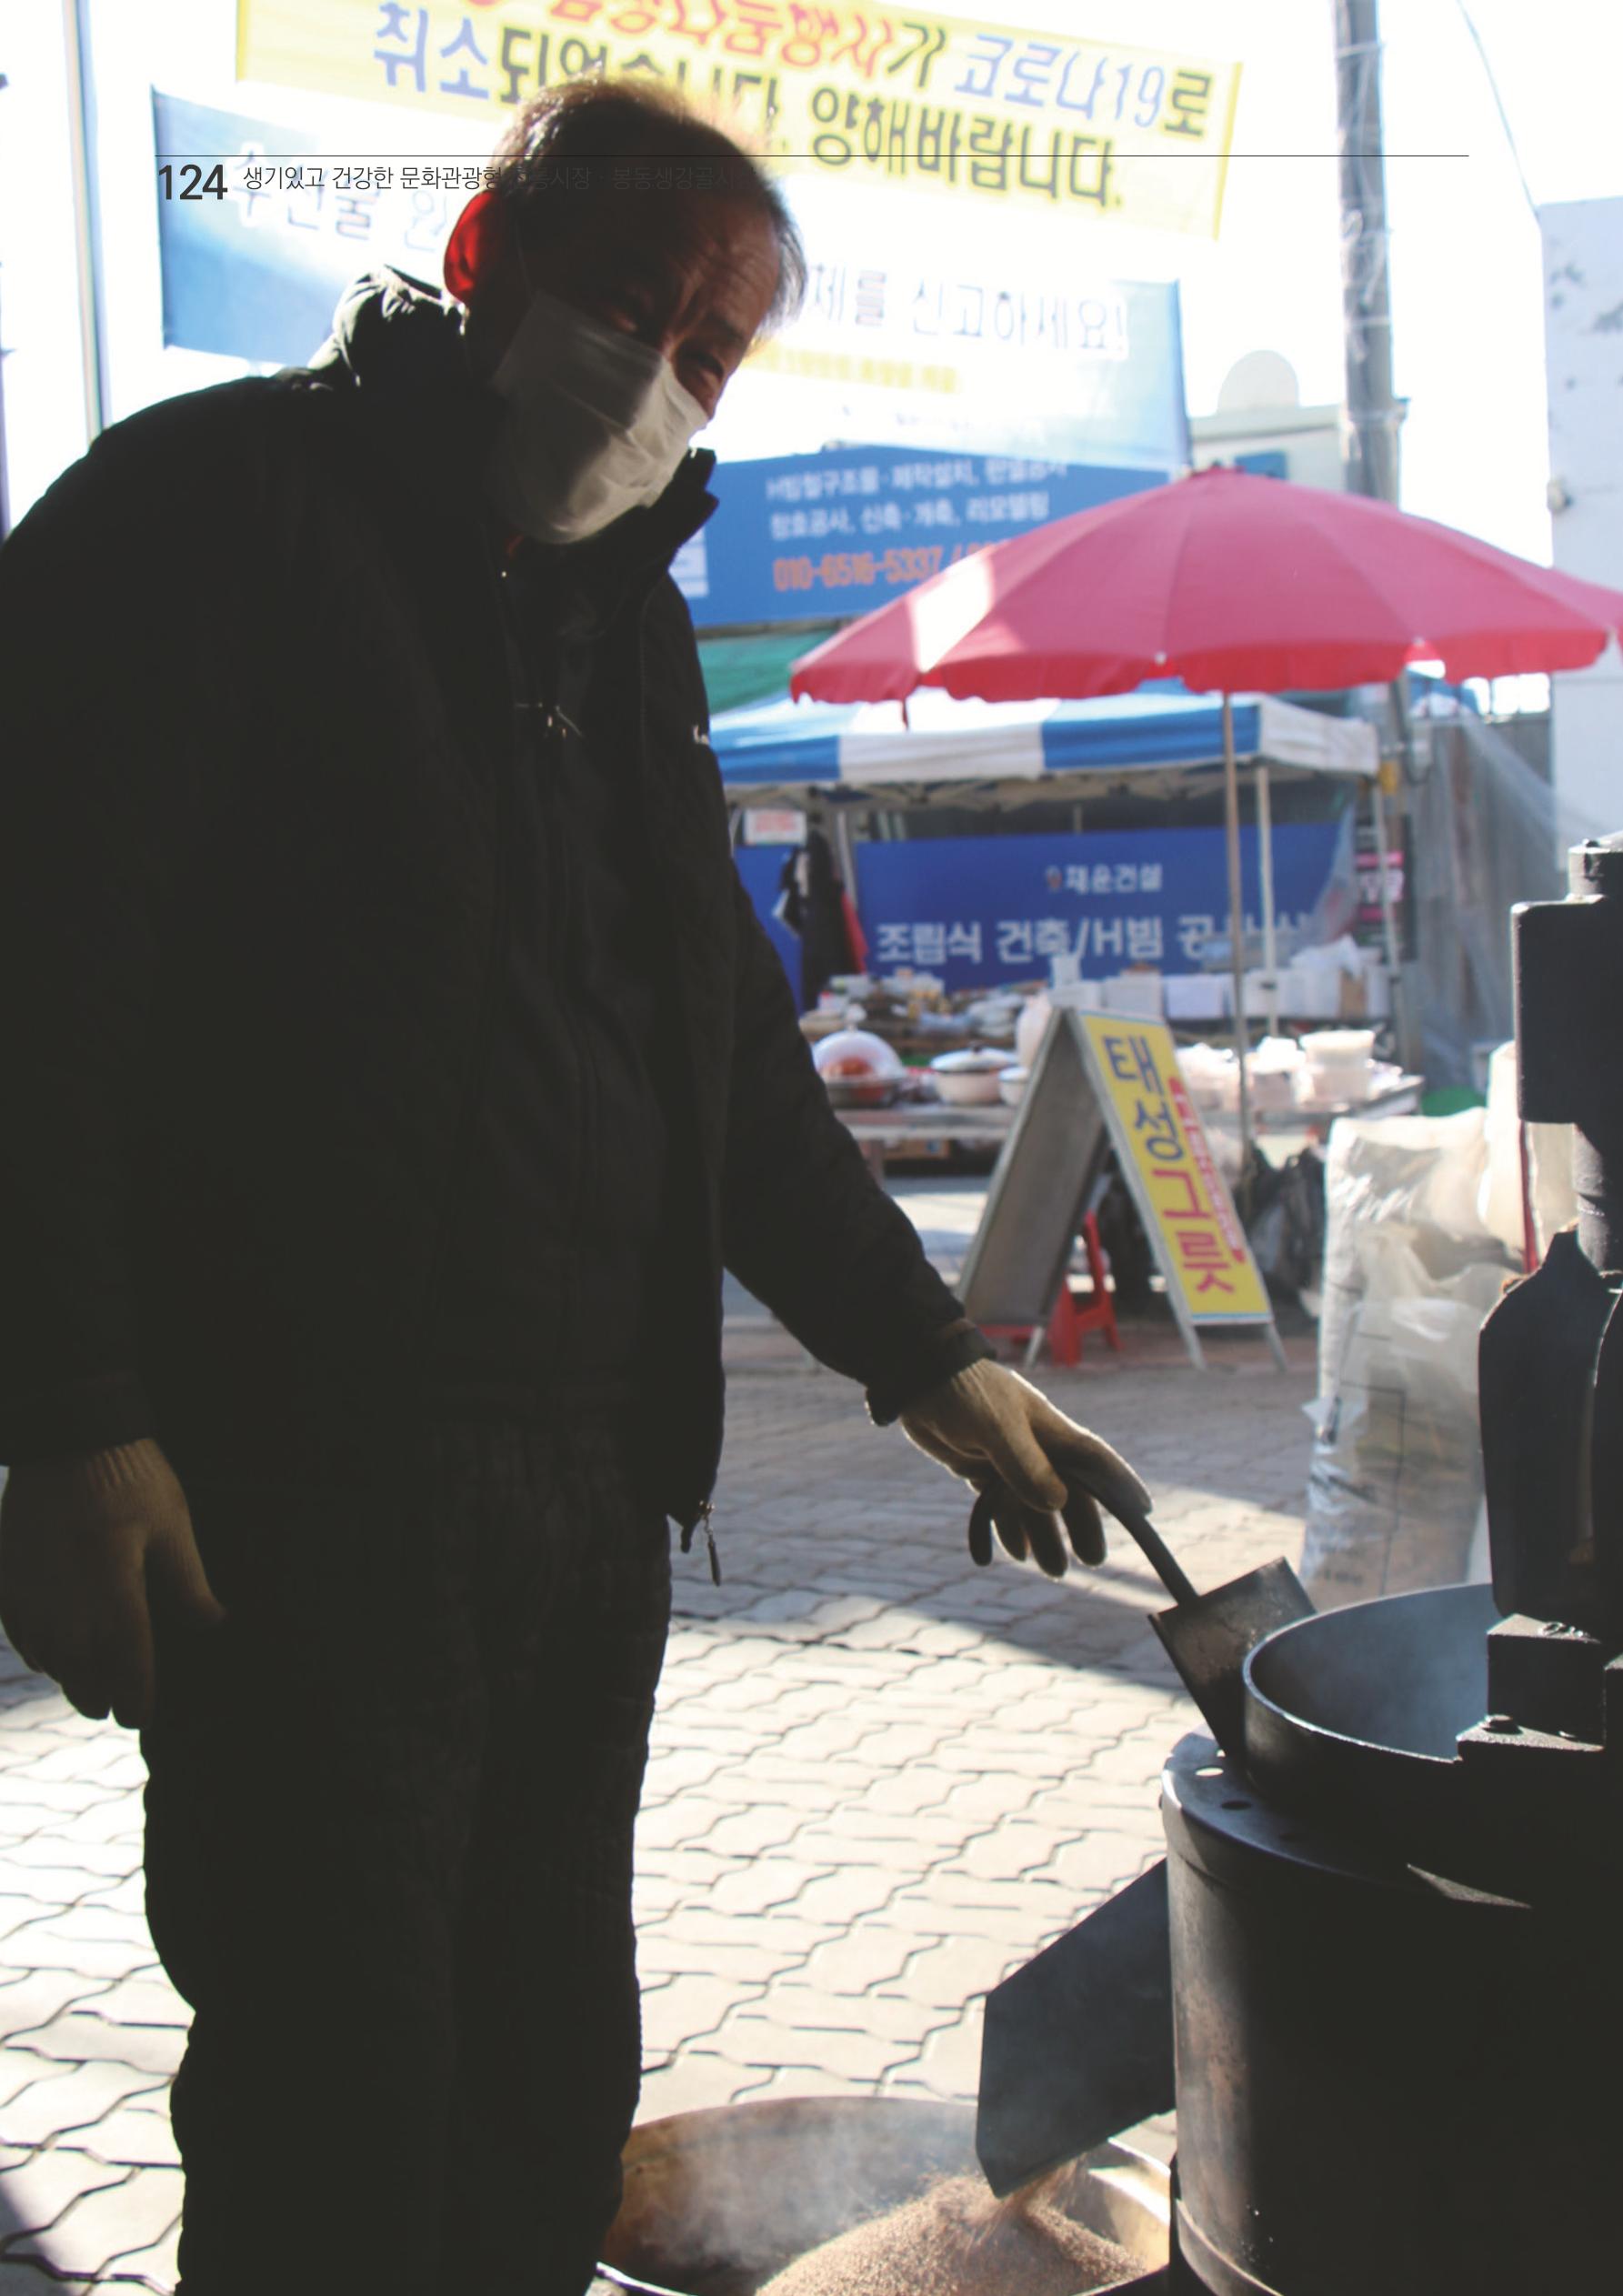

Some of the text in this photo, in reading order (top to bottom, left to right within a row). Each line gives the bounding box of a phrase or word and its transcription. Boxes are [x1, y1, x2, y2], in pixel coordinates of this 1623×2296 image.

[954, 33, 1213, 137] 코로나19로
[811, 86, 1124, 208] 양해바랍니다.
[911, 276, 1125, 352] 신고하세요!
[876, 921, 982, 966] 조립식
